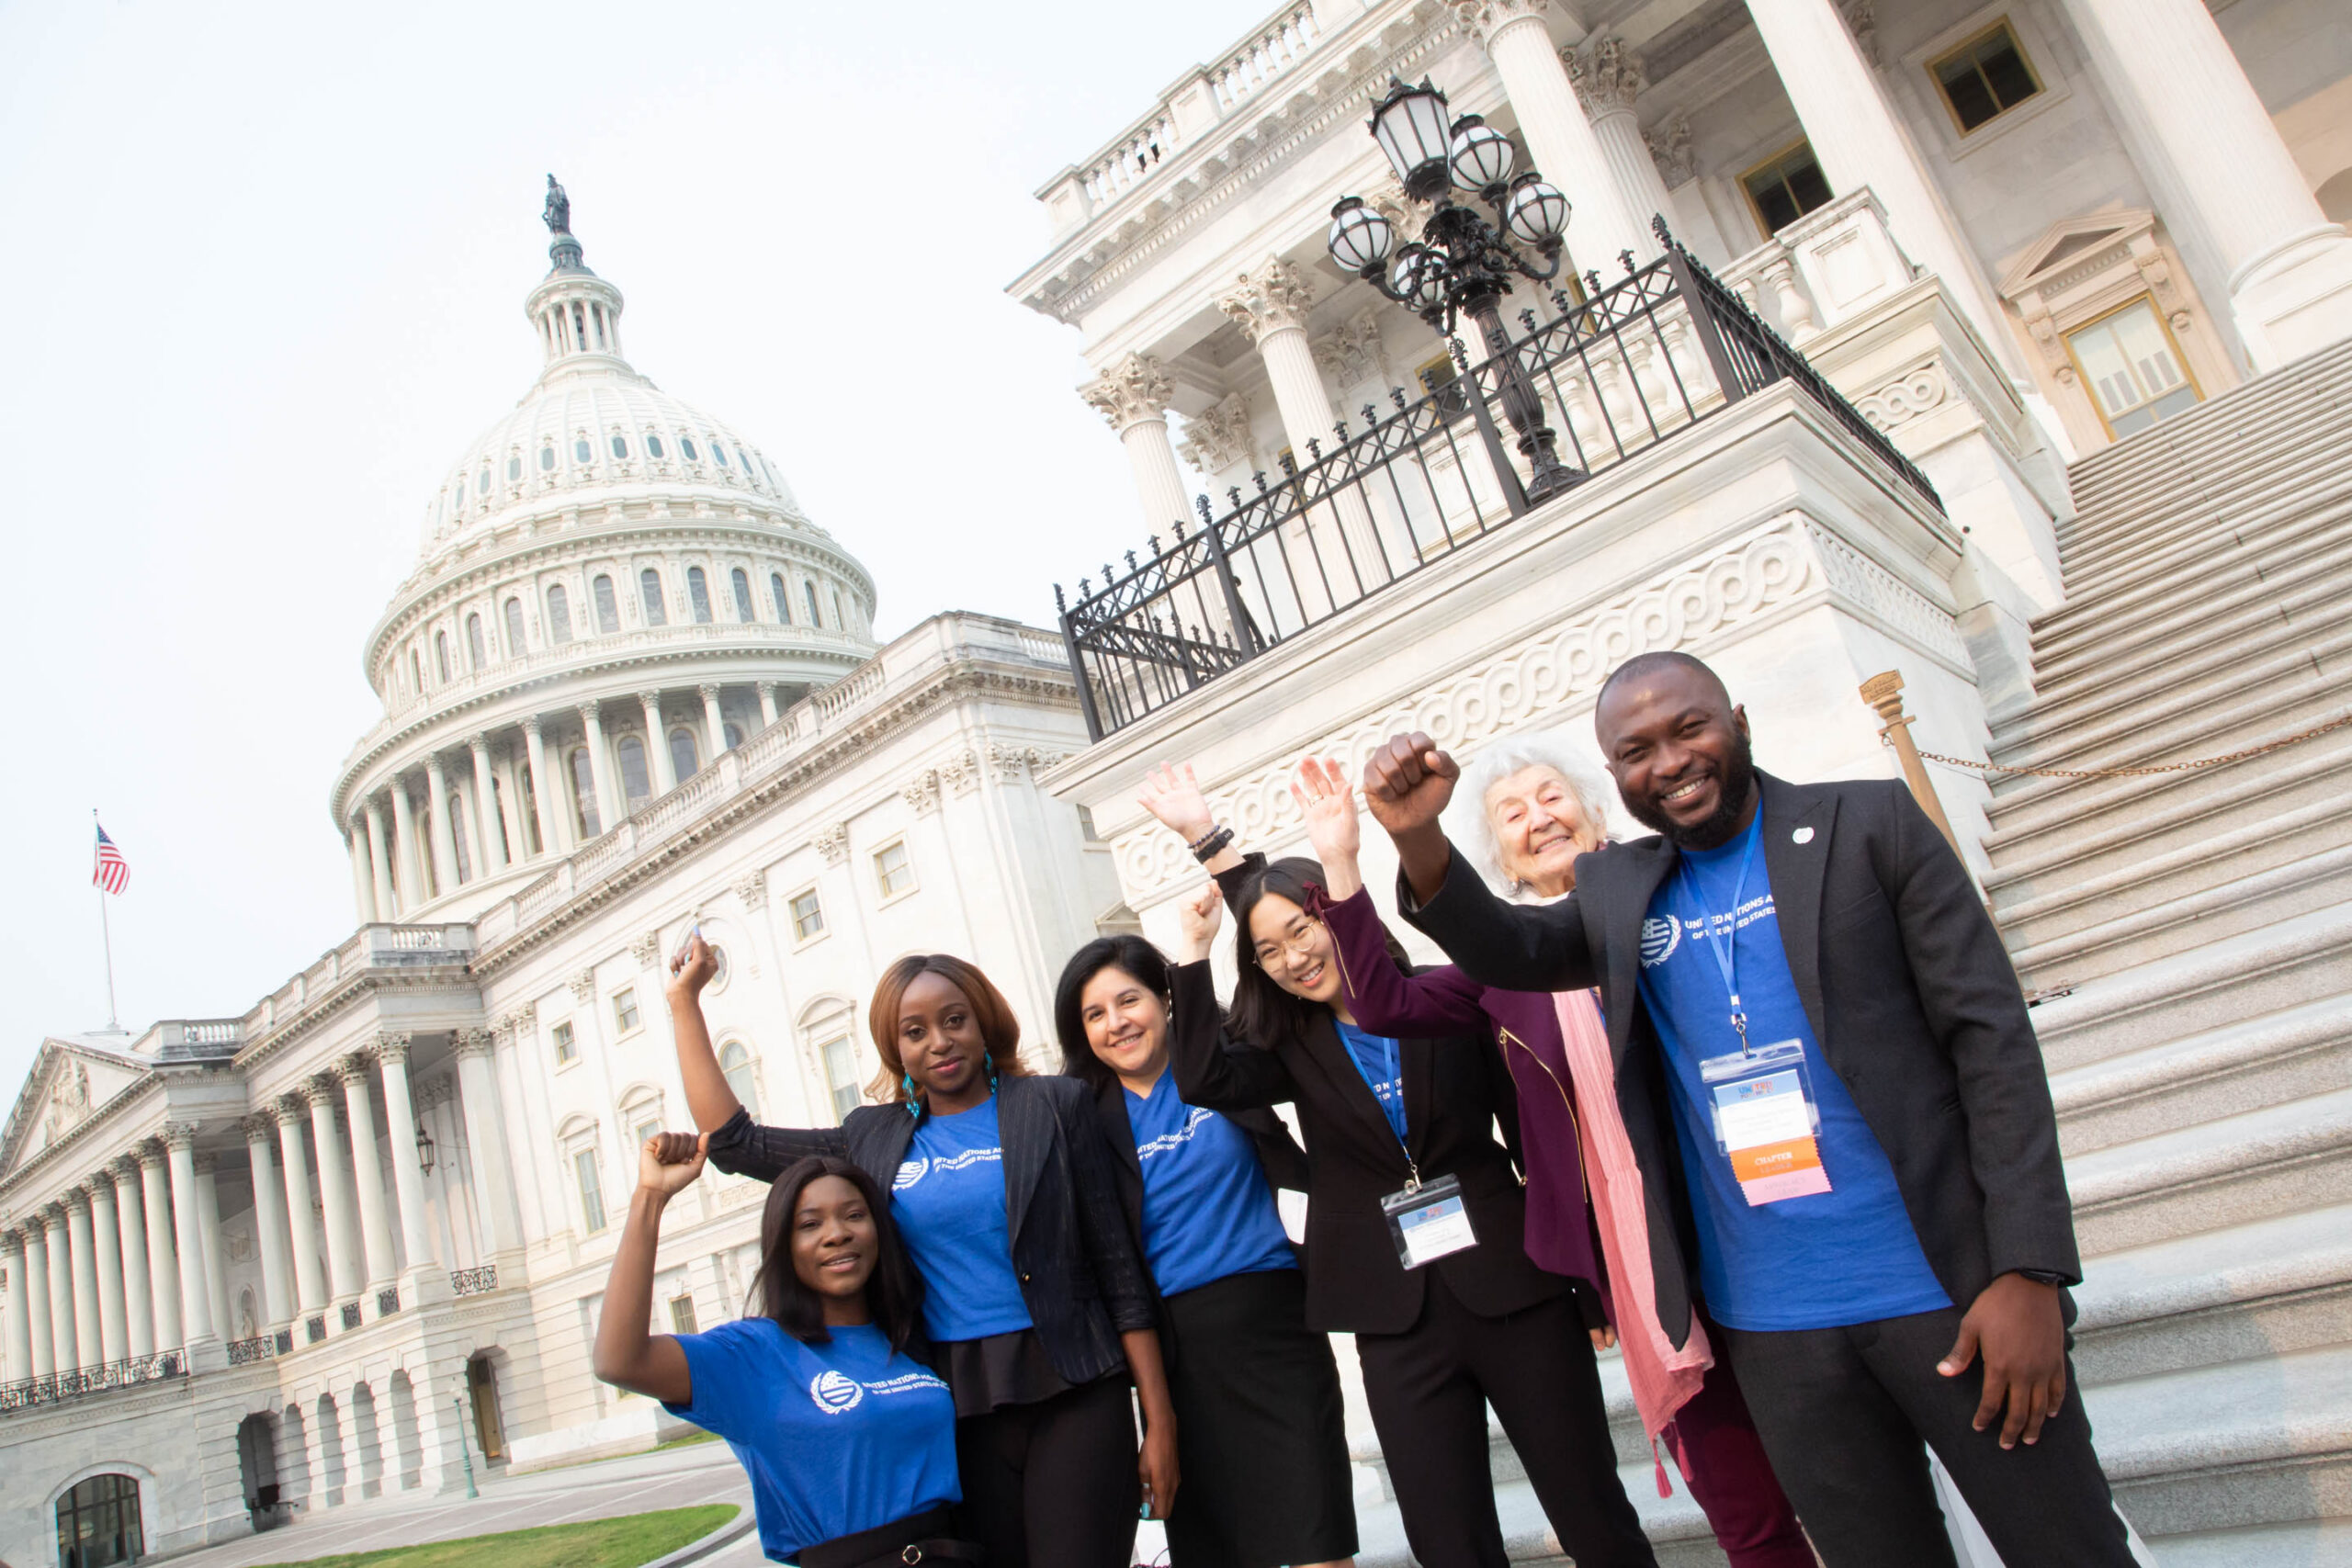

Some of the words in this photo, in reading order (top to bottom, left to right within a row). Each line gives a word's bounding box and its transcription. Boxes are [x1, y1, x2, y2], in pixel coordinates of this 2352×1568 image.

[1685, 915, 1724, 930] UNIED
[1724, 897, 1764, 922] NTIONS
[1692, 931, 1703, 940] OF
[1754, 1151, 1793, 1167] CHAPTER
